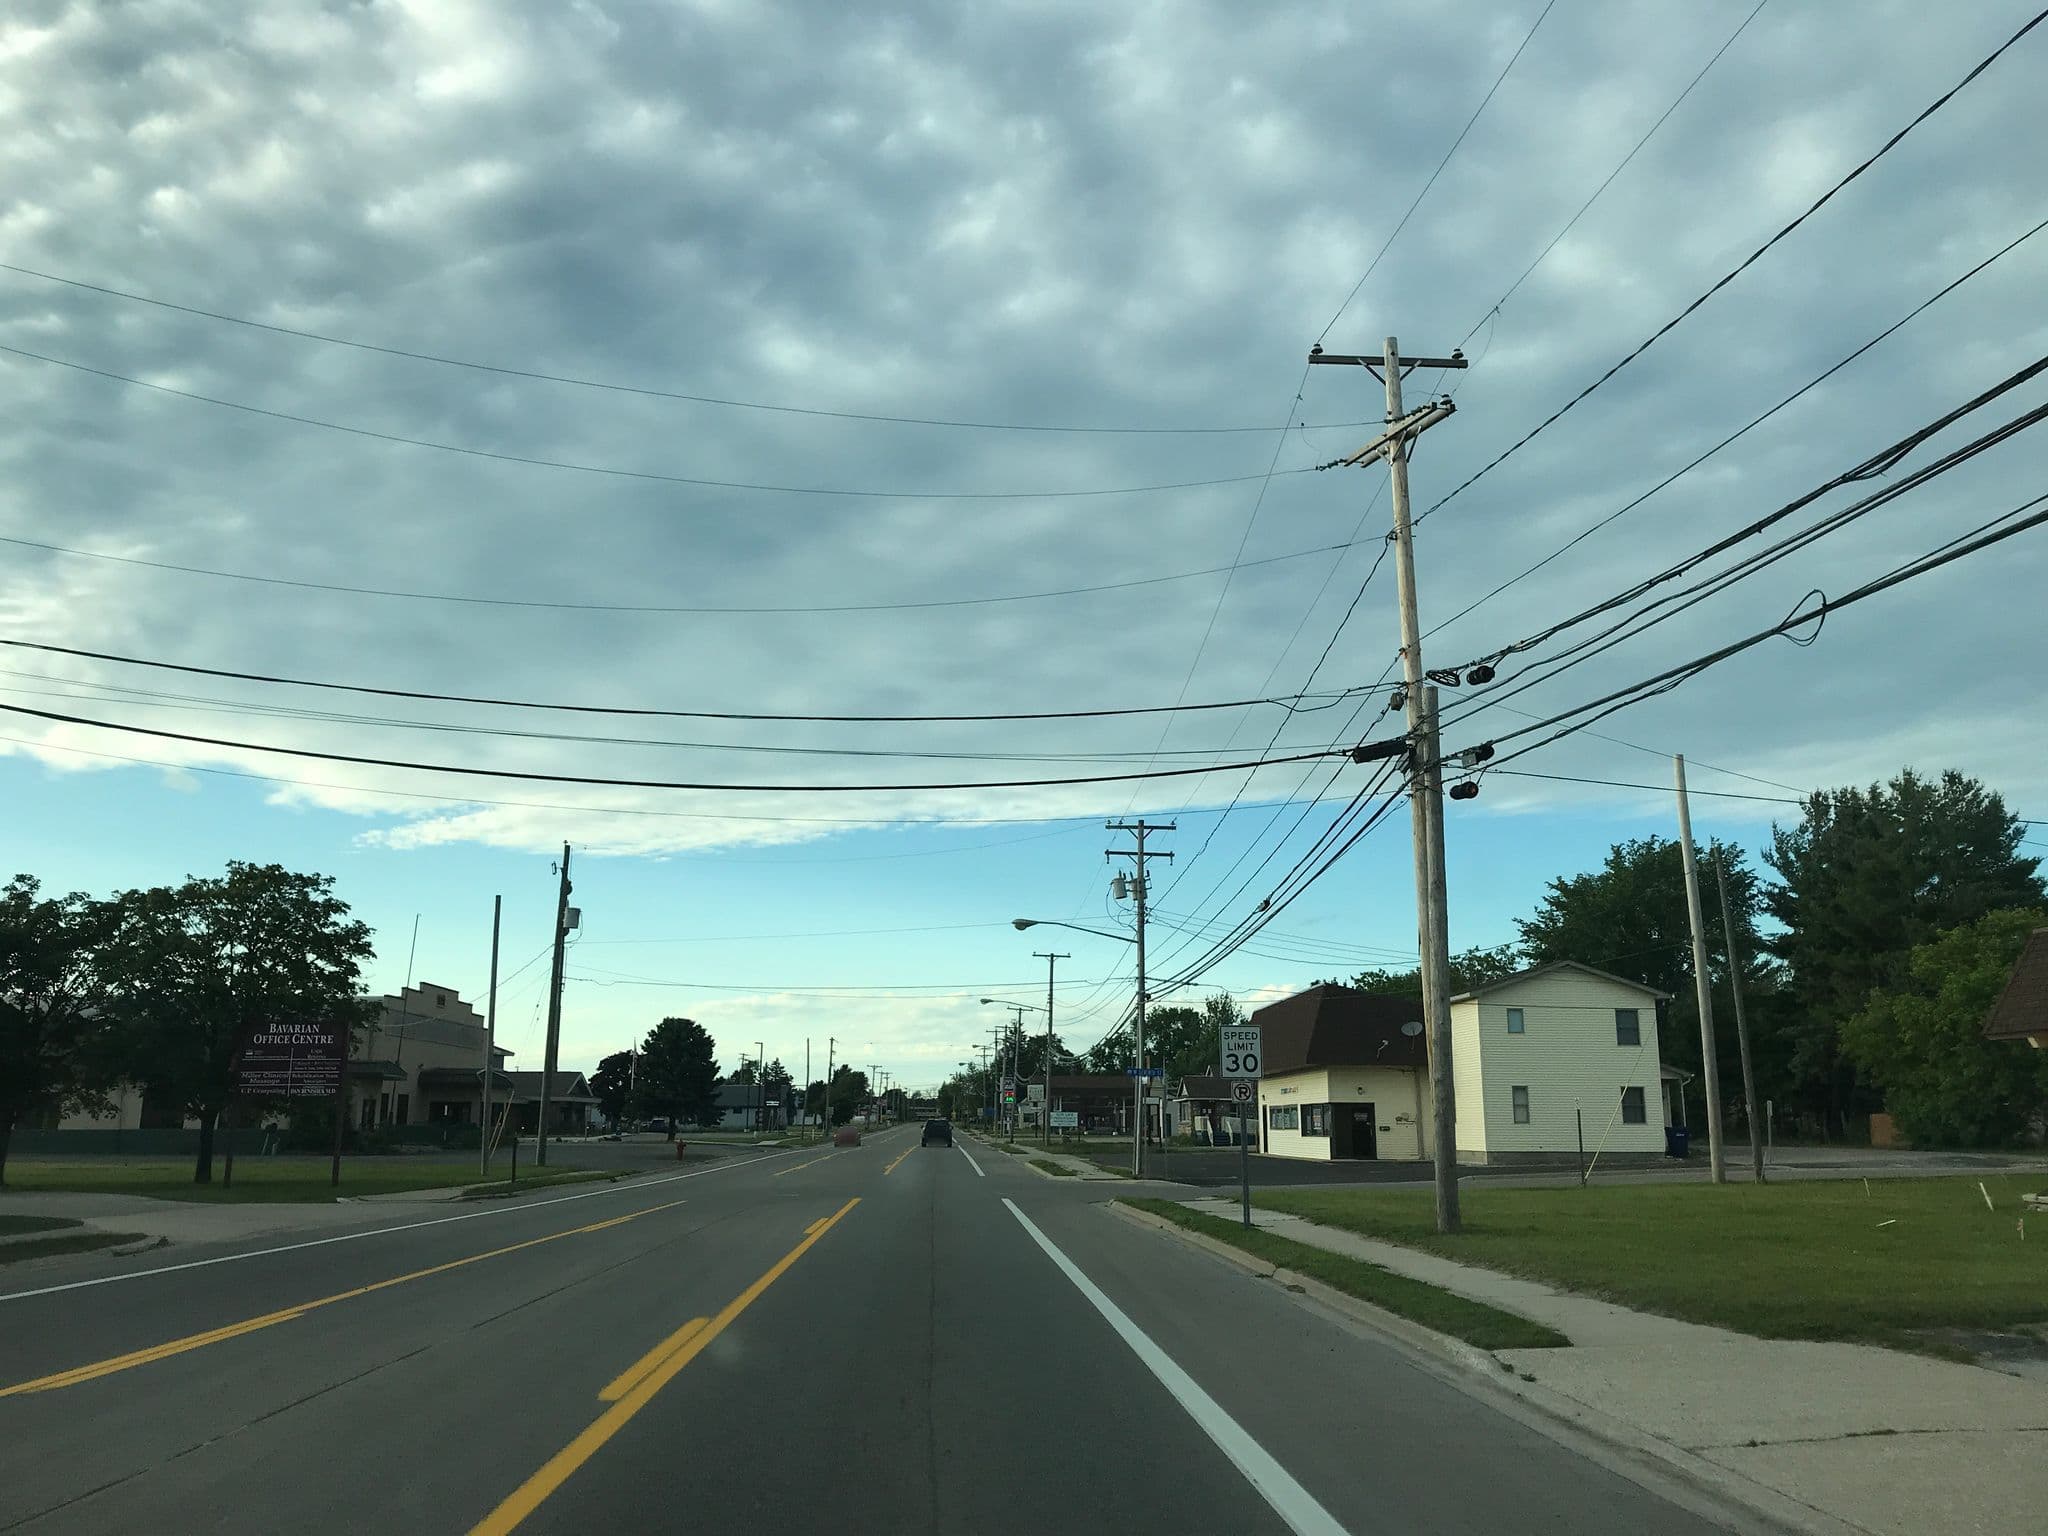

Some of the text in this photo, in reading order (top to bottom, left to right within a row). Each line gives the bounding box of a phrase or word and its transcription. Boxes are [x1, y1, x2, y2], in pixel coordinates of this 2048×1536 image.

[269, 1023, 320, 1033] BAVARIAN
[253, 1033, 334, 1044] OFFICE CENTRE
[1223, 1031, 1258, 1041] SPEED
[1227, 1042, 1255, 1051] LIMIT
[1225, 1053, 1259, 1073] 30
